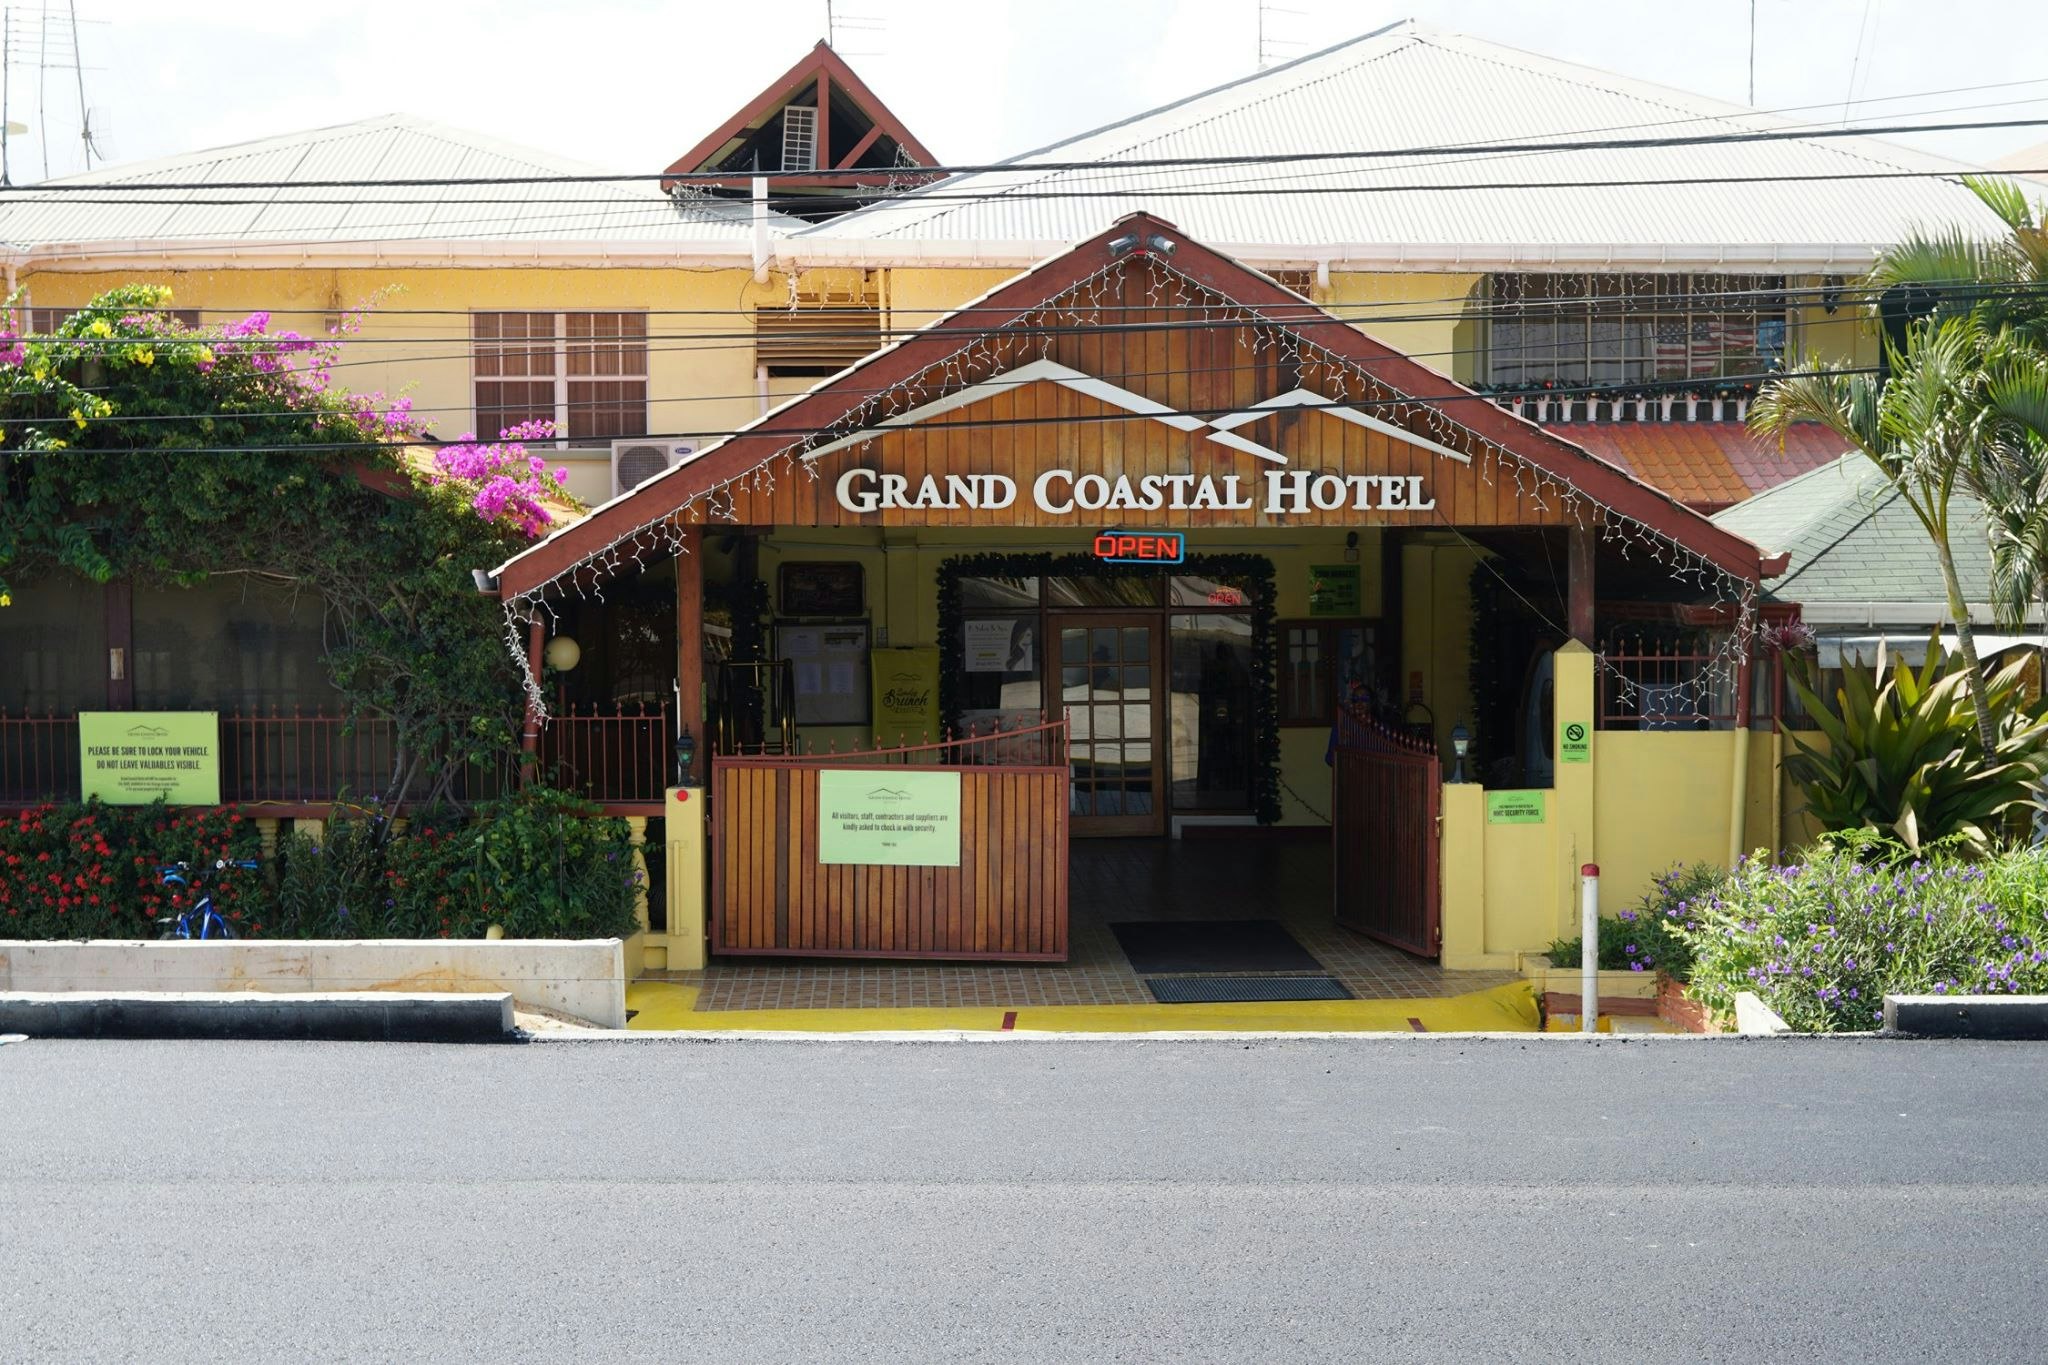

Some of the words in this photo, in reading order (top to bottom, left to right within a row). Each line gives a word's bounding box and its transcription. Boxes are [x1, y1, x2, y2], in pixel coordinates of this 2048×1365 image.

[837, 468, 1017, 514] GRAND
[1033, 469, 1253, 515] COASTAL
[1263, 470, 1436, 515] HOTEL
[1094, 536, 1178, 558] OPEN
[1207, 592, 1242, 605] OPEN
[88, 746, 110, 756] PLEASE
[111, 746, 120, 756] BE
[121, 746, 137, 756] SURE
[138, 746, 146, 756] TO
[147, 746, 163, 756] LOCK
[164, 746, 181, 756] YOUR
[96, 759, 106, 769] DO
[106, 759, 119, 769] NOT
[120, 759, 138, 769] LEAVE
[139, 759, 175, 769] VALUABLES
[840, 812, 859, 821] visitors,
[860, 812, 875, 821] staff,
[875, 813, 904, 821] contractors
[905, 813, 915, 821] and
[915, 813, 939, 822] suppliers
[842, 823, 858, 833] kindly
[859, 823, 874, 832] asked
[874, 824, 880, 832] to
[881, 824, 896, 832] check
[902, 824, 914, 832] with
[914, 825, 936, 834] security.
